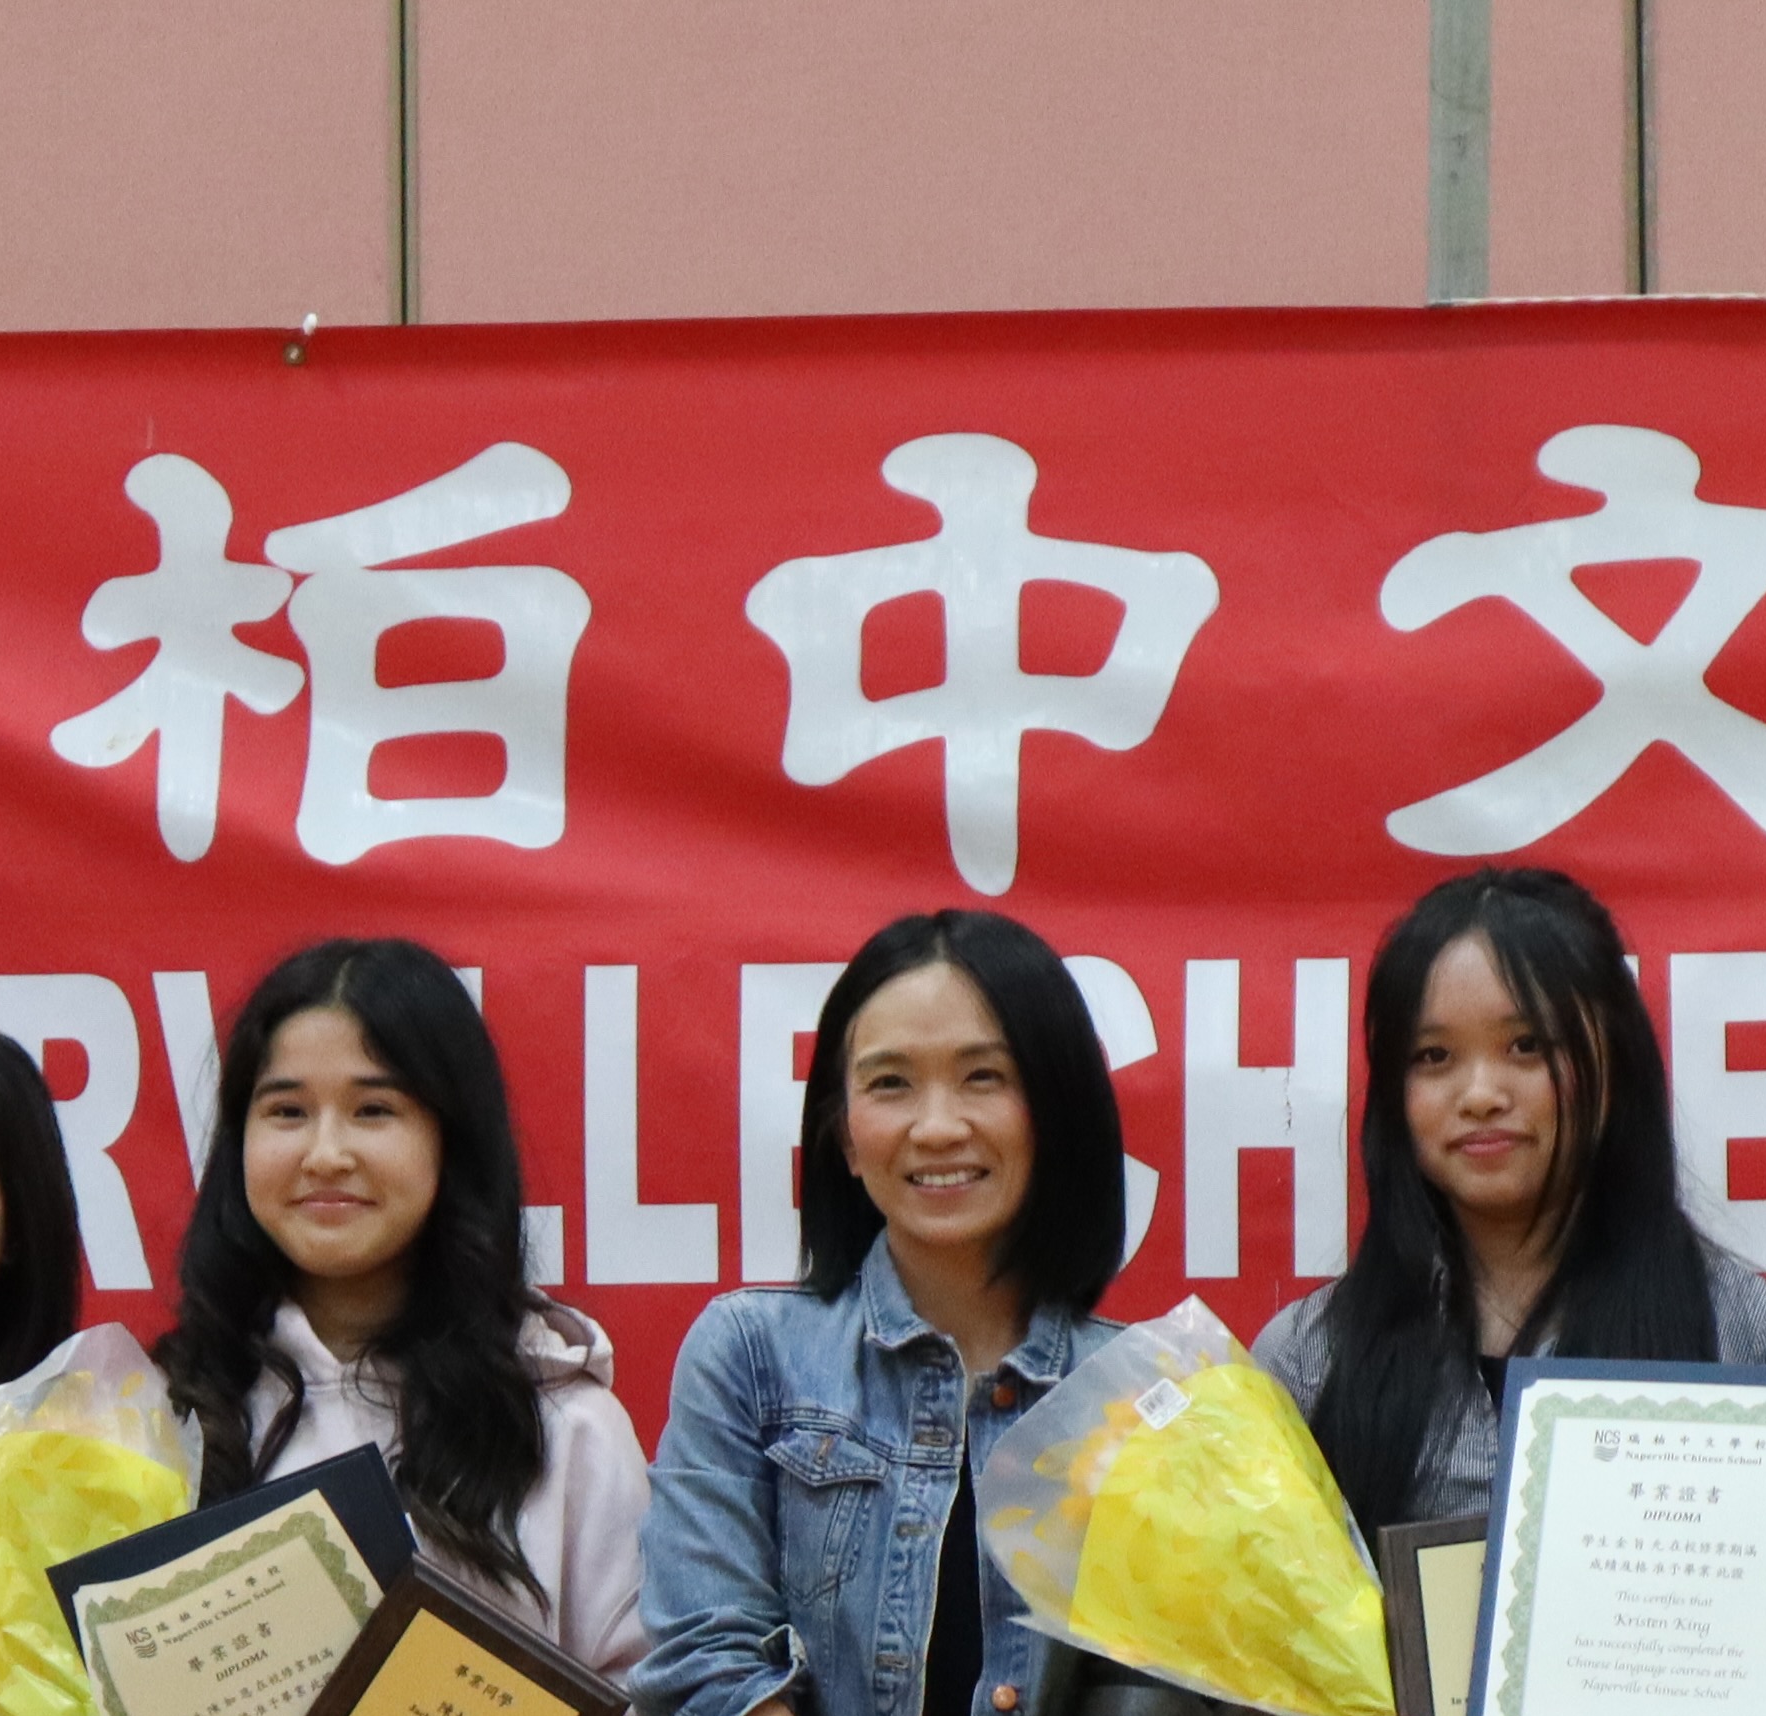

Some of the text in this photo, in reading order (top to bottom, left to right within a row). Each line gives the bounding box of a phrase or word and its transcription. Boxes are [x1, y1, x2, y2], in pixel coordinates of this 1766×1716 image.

[1594, 1429, 1621, 1445] NCS
[1626, 1451, 1762, 1466] Naperville Chinese School
[1628, 1482, 1722, 1504] 畢業證書
[1643, 1510, 1702, 1523] DIPLOMA
[1615, 1590, 1639, 1603] This
[1689, 1594, 1714, 1607] that
[163, 1579, 286, 1646] Naperville Chinese School
[125, 1627, 152, 1645] NCS
[1614, 1613, 1711, 1638] Kristen King
[188, 1621, 272, 1672] 畢業證書
[1598, 1637, 1664, 1655] successfully
[1667, 1643, 1724, 1658] completed
[1727, 1646, 1745, 1658] the
[216, 1649, 268, 1682] DIPLOMA
[1613, 1658, 1667, 1678] language
[1670, 1667, 1711, 1678] courses
[1714, 1669, 1728, 1679] at
[1730, 1667, 1748, 1680] the
[1581, 1676, 1642, 1695] Naperville
[1693, 1686, 1732, 1700] School
